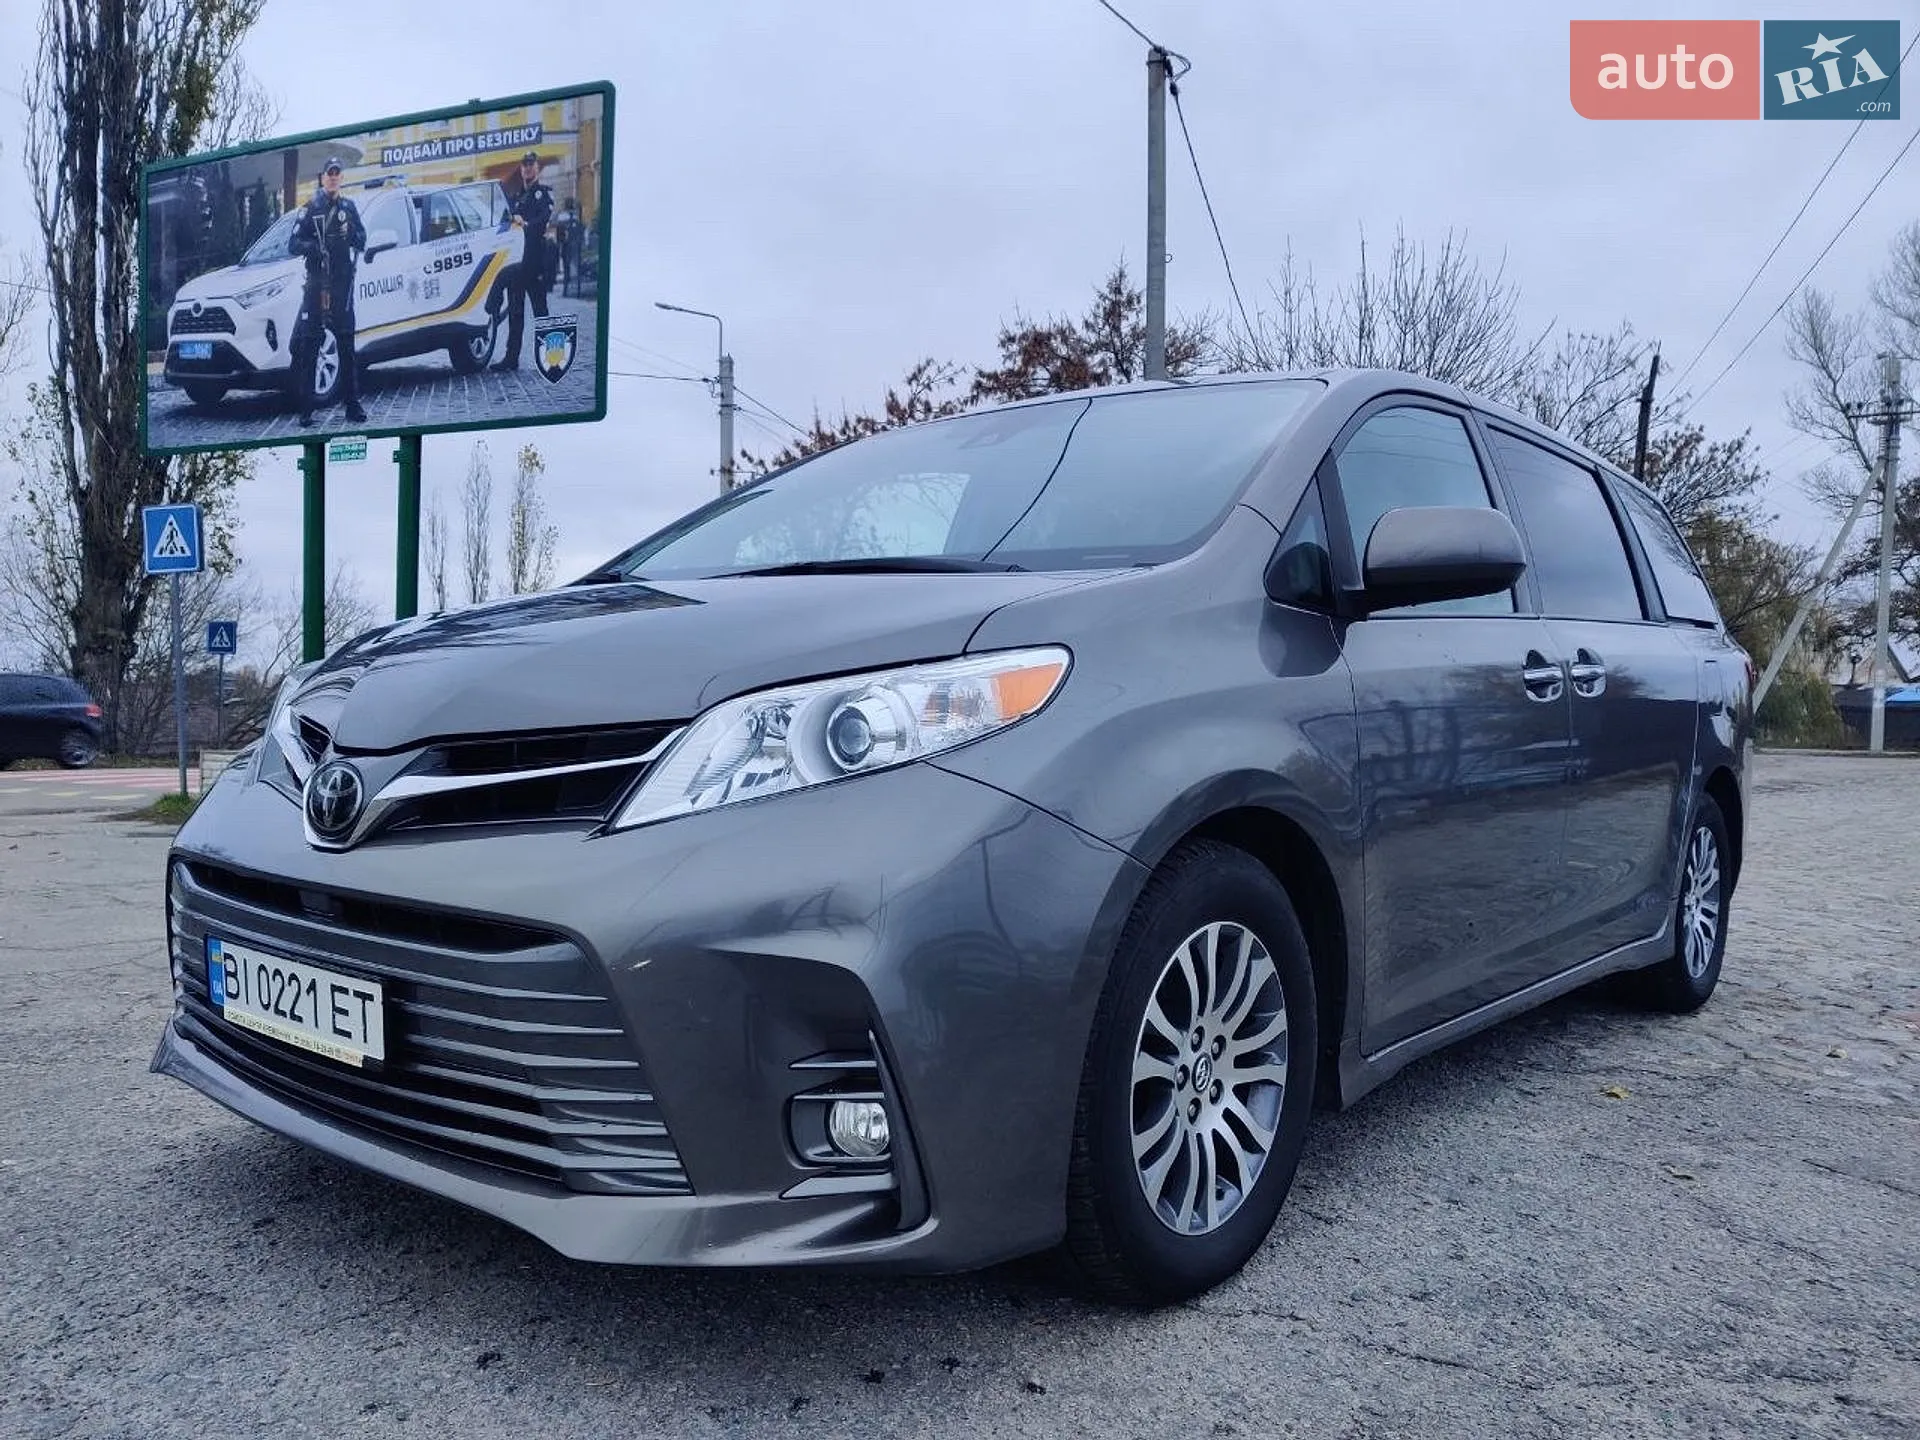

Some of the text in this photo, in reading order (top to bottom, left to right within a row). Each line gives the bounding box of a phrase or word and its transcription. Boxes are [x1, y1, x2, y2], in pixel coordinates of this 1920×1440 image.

[383, 126, 540, 165] ПОДБАЙ ПРО БЕЗПЕКУ
[433, 251, 473, 274] 9899
[359, 274, 404, 300] ПОЛІЦІЯ
[223, 951, 249, 1005] BI
[257, 963, 319, 1029] 0221
[330, 983, 374, 1044] ET
